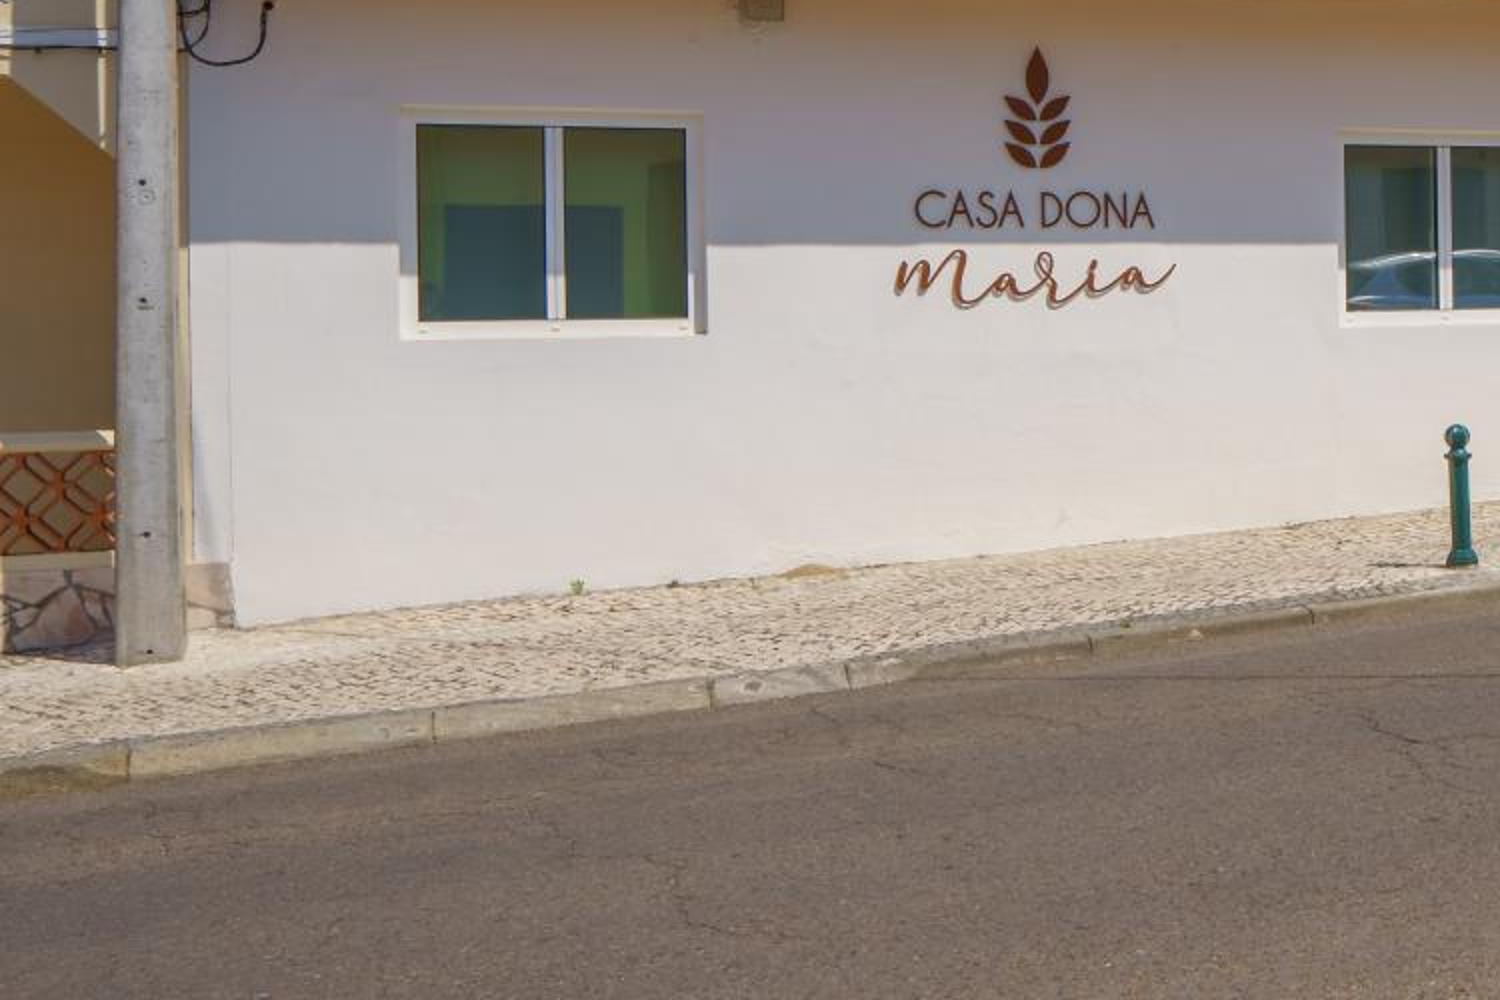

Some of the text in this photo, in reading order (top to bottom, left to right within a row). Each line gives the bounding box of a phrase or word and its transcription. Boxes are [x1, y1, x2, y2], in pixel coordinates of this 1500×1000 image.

[914, 189, 1155, 228] CASA DONA
[894, 249, 1177, 310] Maria
